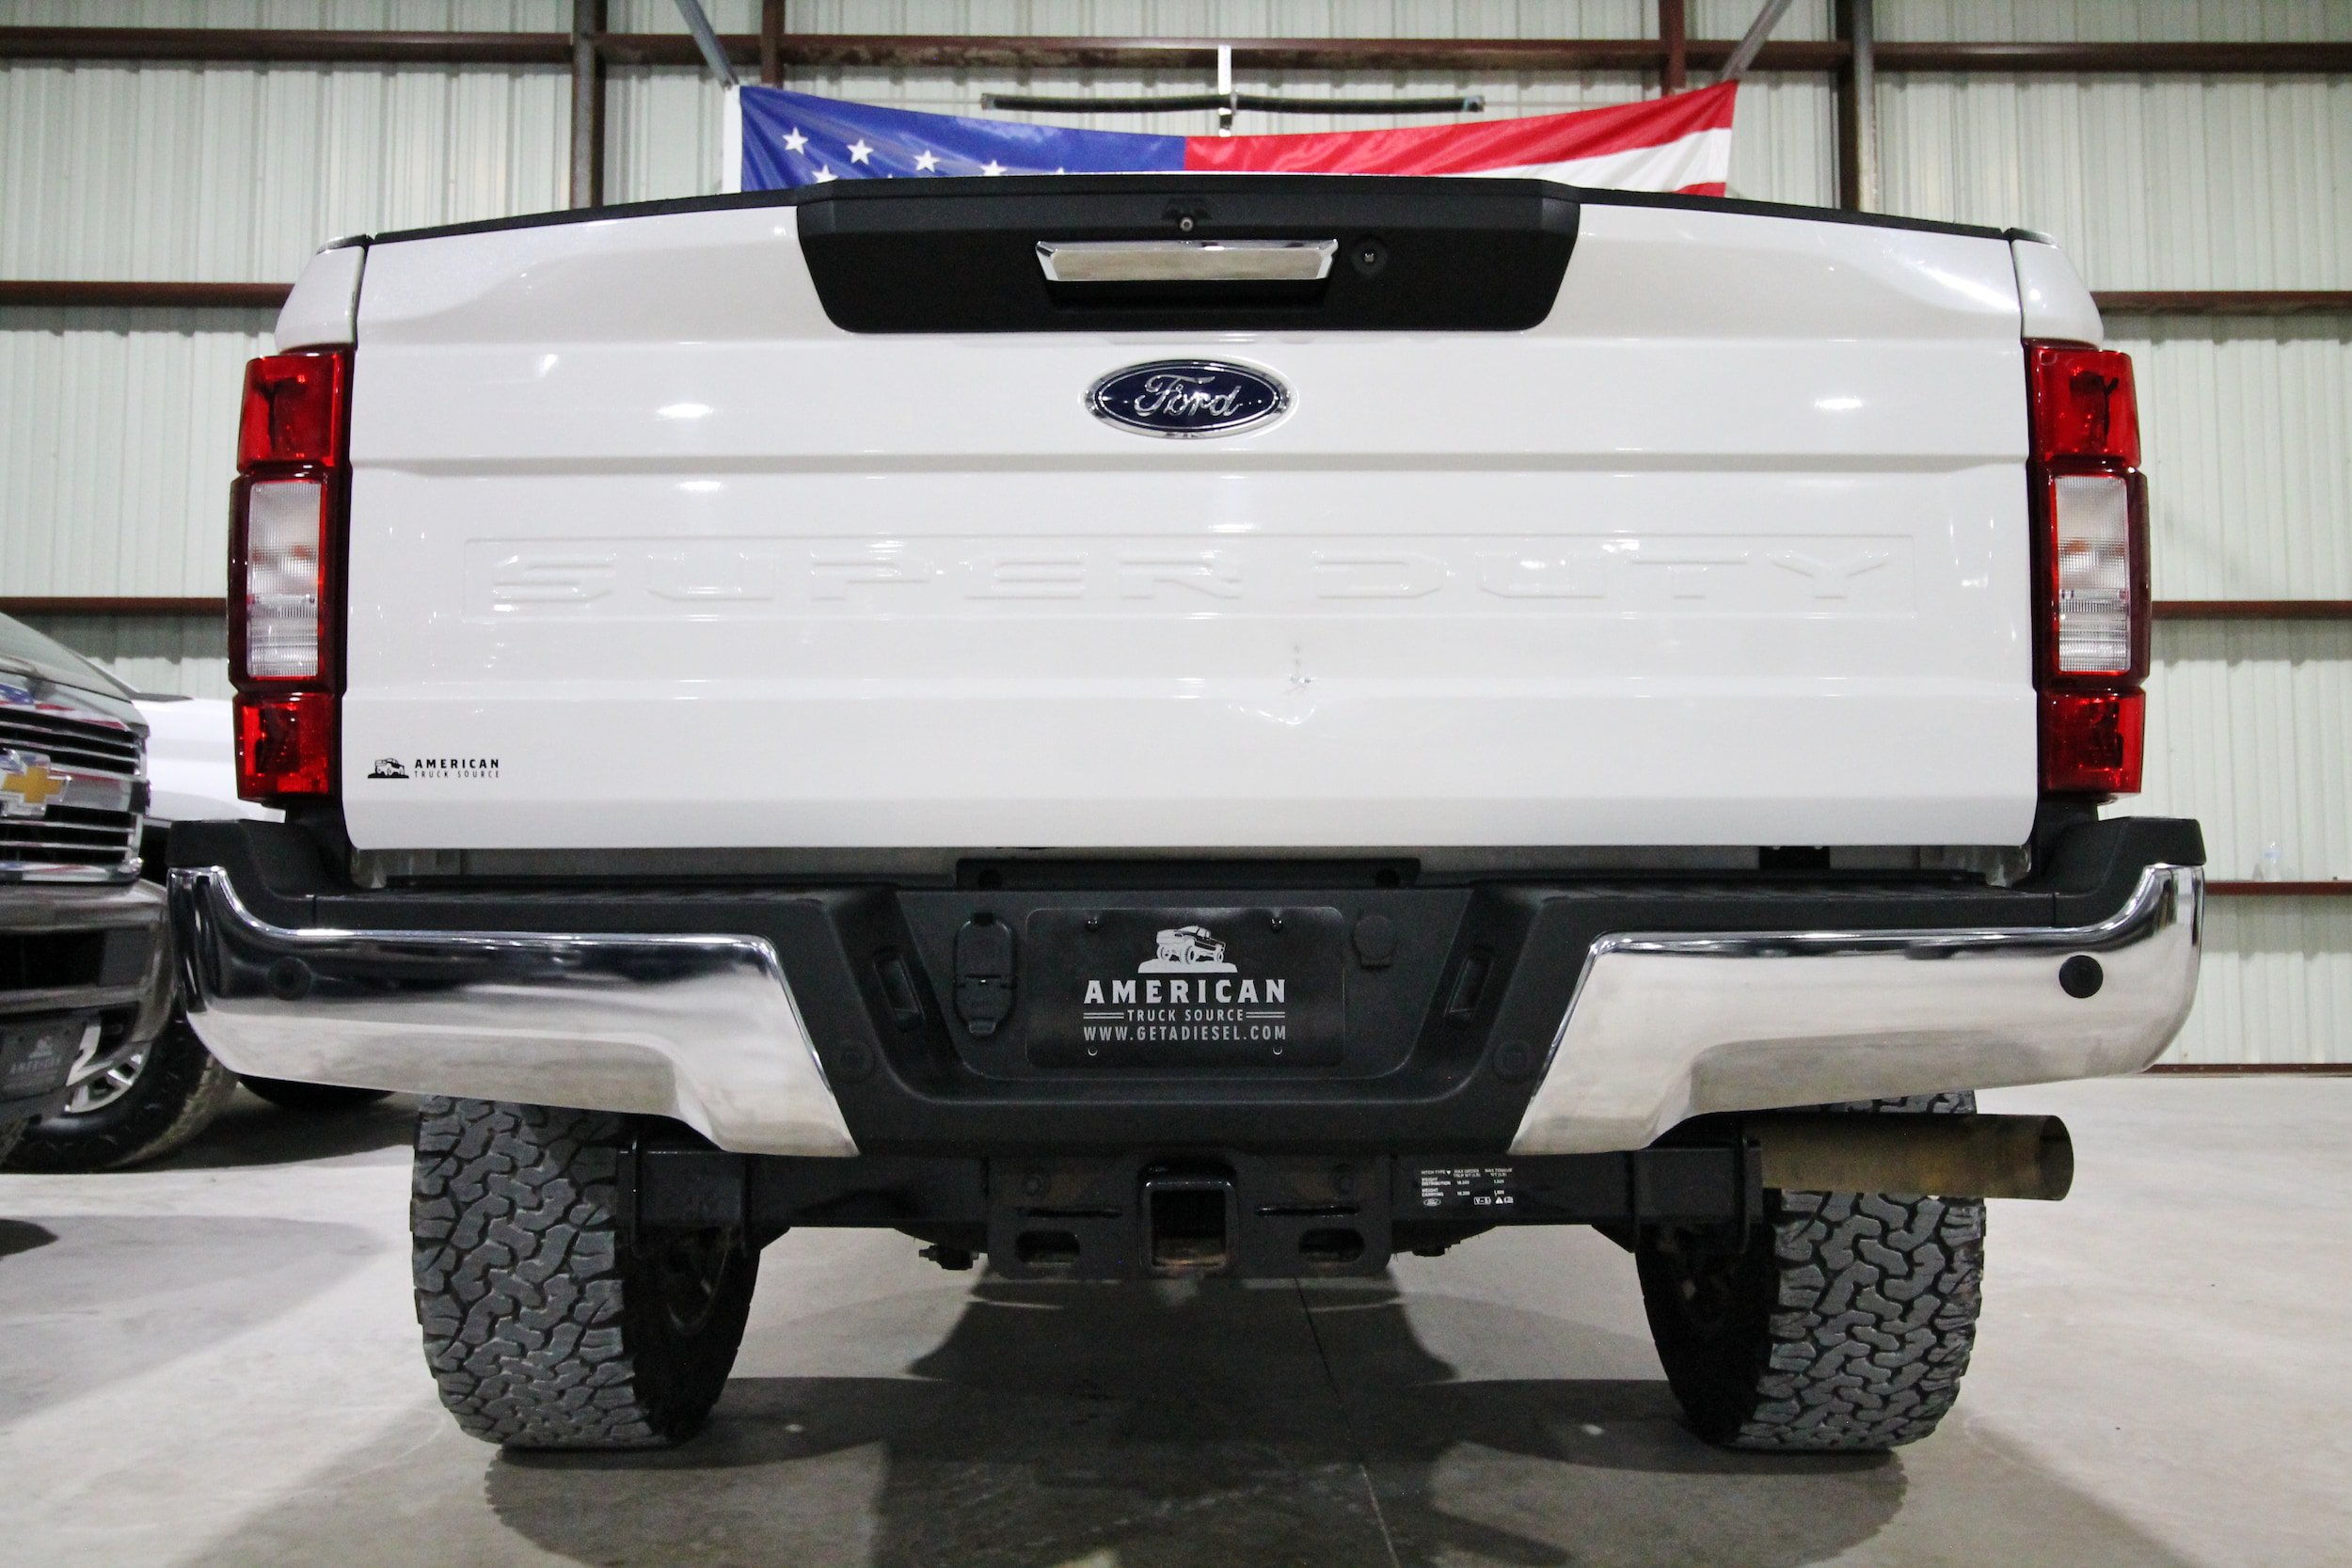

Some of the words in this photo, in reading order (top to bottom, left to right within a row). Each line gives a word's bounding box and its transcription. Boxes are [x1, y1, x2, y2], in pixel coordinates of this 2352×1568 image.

[1134, 374, 1243, 417] Ford
[491, 550, 1243, 602] SUPER
[1311, 548, 1889, 600] DUTY
[415, 759, 500, 769] AMERICAN
[414, 770, 449, 779] TRUCK
[457, 770, 500, 779] SOURCE
[1083, 978, 1286, 1005] AMERICAN
[1127, 1008, 1177, 1022] TRUCK
[1184, 1008, 1244, 1022] SOURCE
[1083, 1024, 1287, 1041] WWW.GETADIESEL.COM
